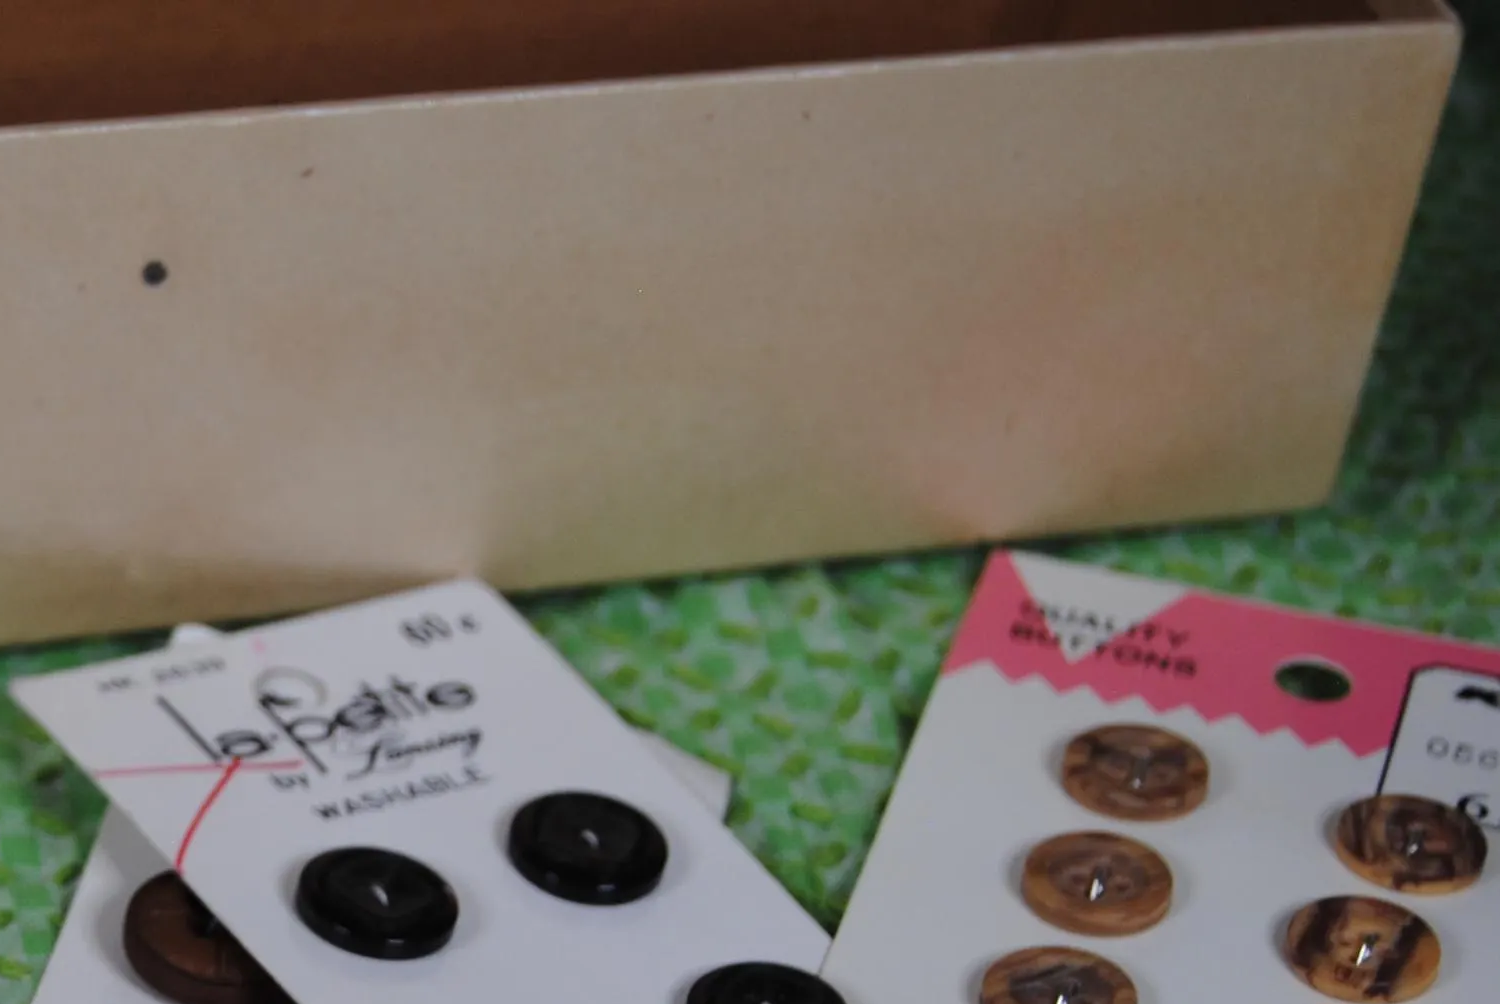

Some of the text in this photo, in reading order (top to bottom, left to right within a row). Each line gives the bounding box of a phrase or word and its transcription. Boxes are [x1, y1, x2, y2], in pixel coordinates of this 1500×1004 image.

[1009, 619, 1197, 680] BUTTONS
[1018, 596, 1191, 650] QUALITY
[312, 766, 492, 821] WASHABLE
